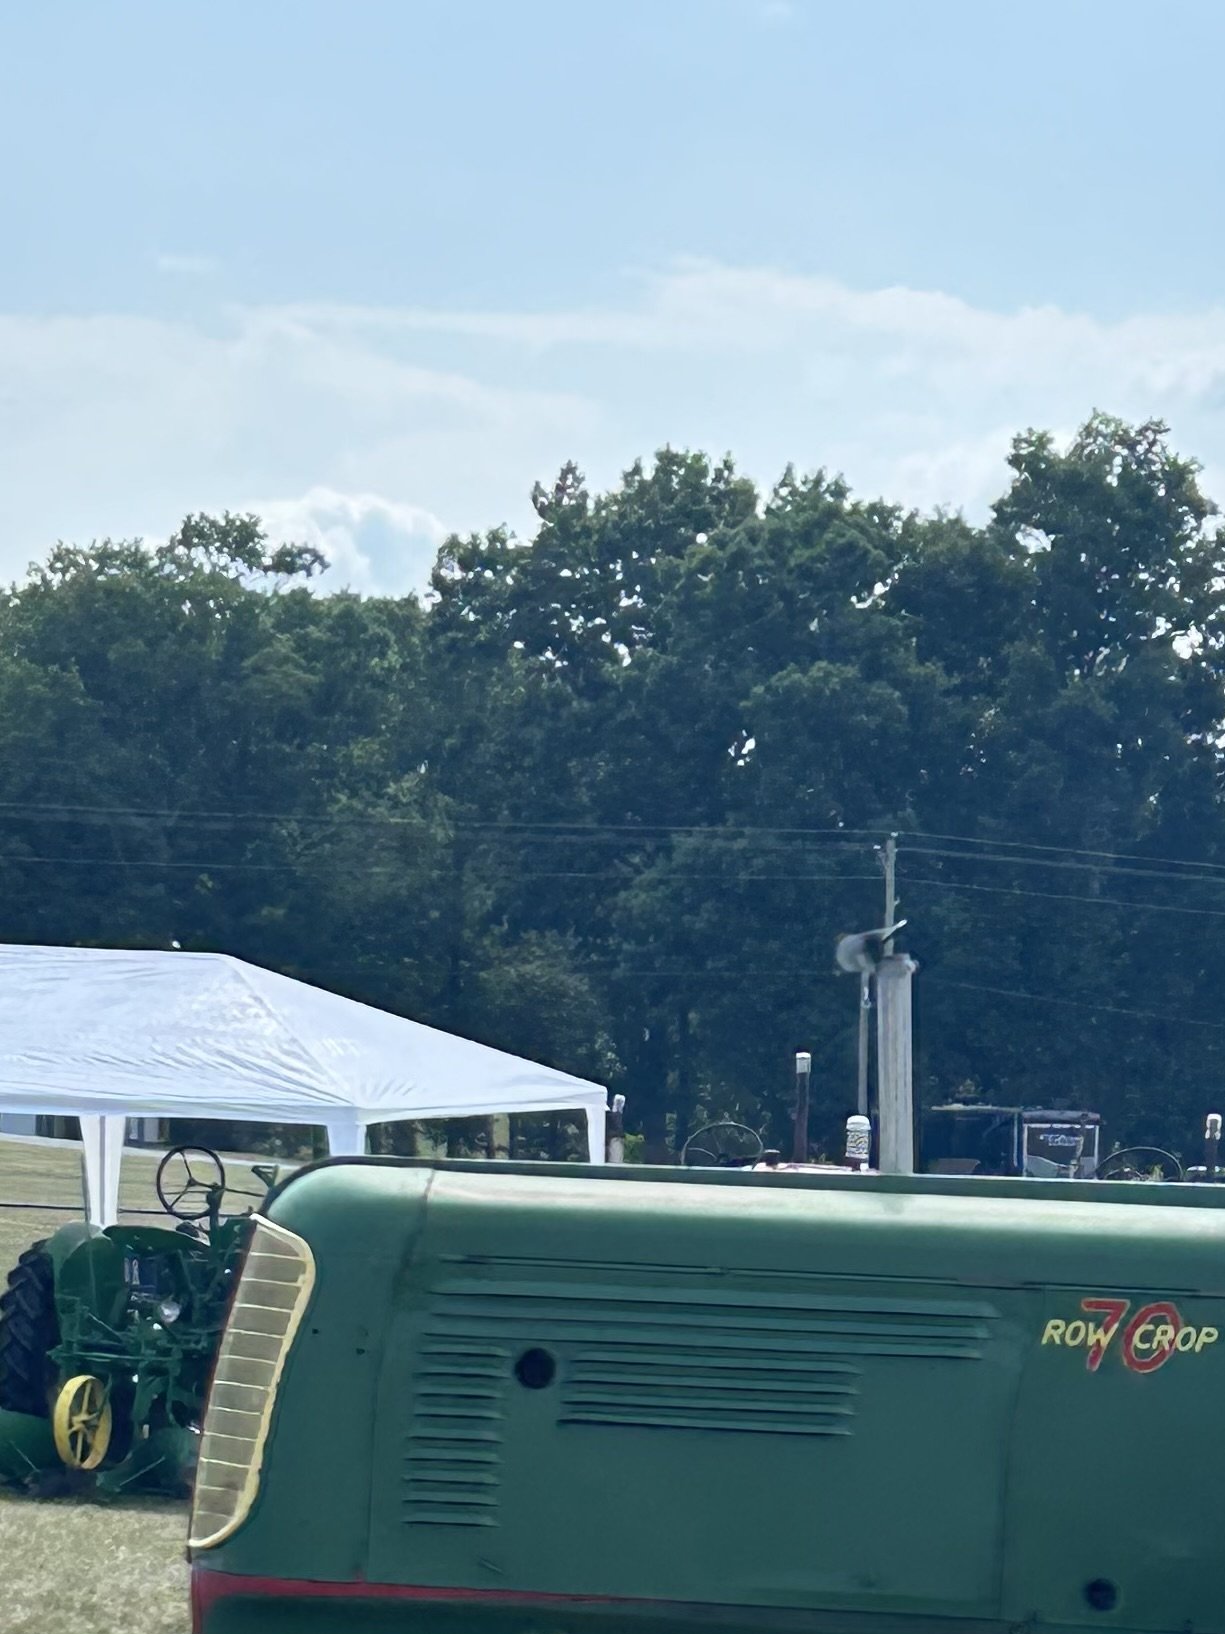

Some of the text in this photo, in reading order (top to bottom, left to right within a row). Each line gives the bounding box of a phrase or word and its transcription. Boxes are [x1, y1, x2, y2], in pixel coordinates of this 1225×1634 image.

[1041, 1318, 1219, 1353] ROW CROP
[1081, 1297, 1183, 1373] 70
